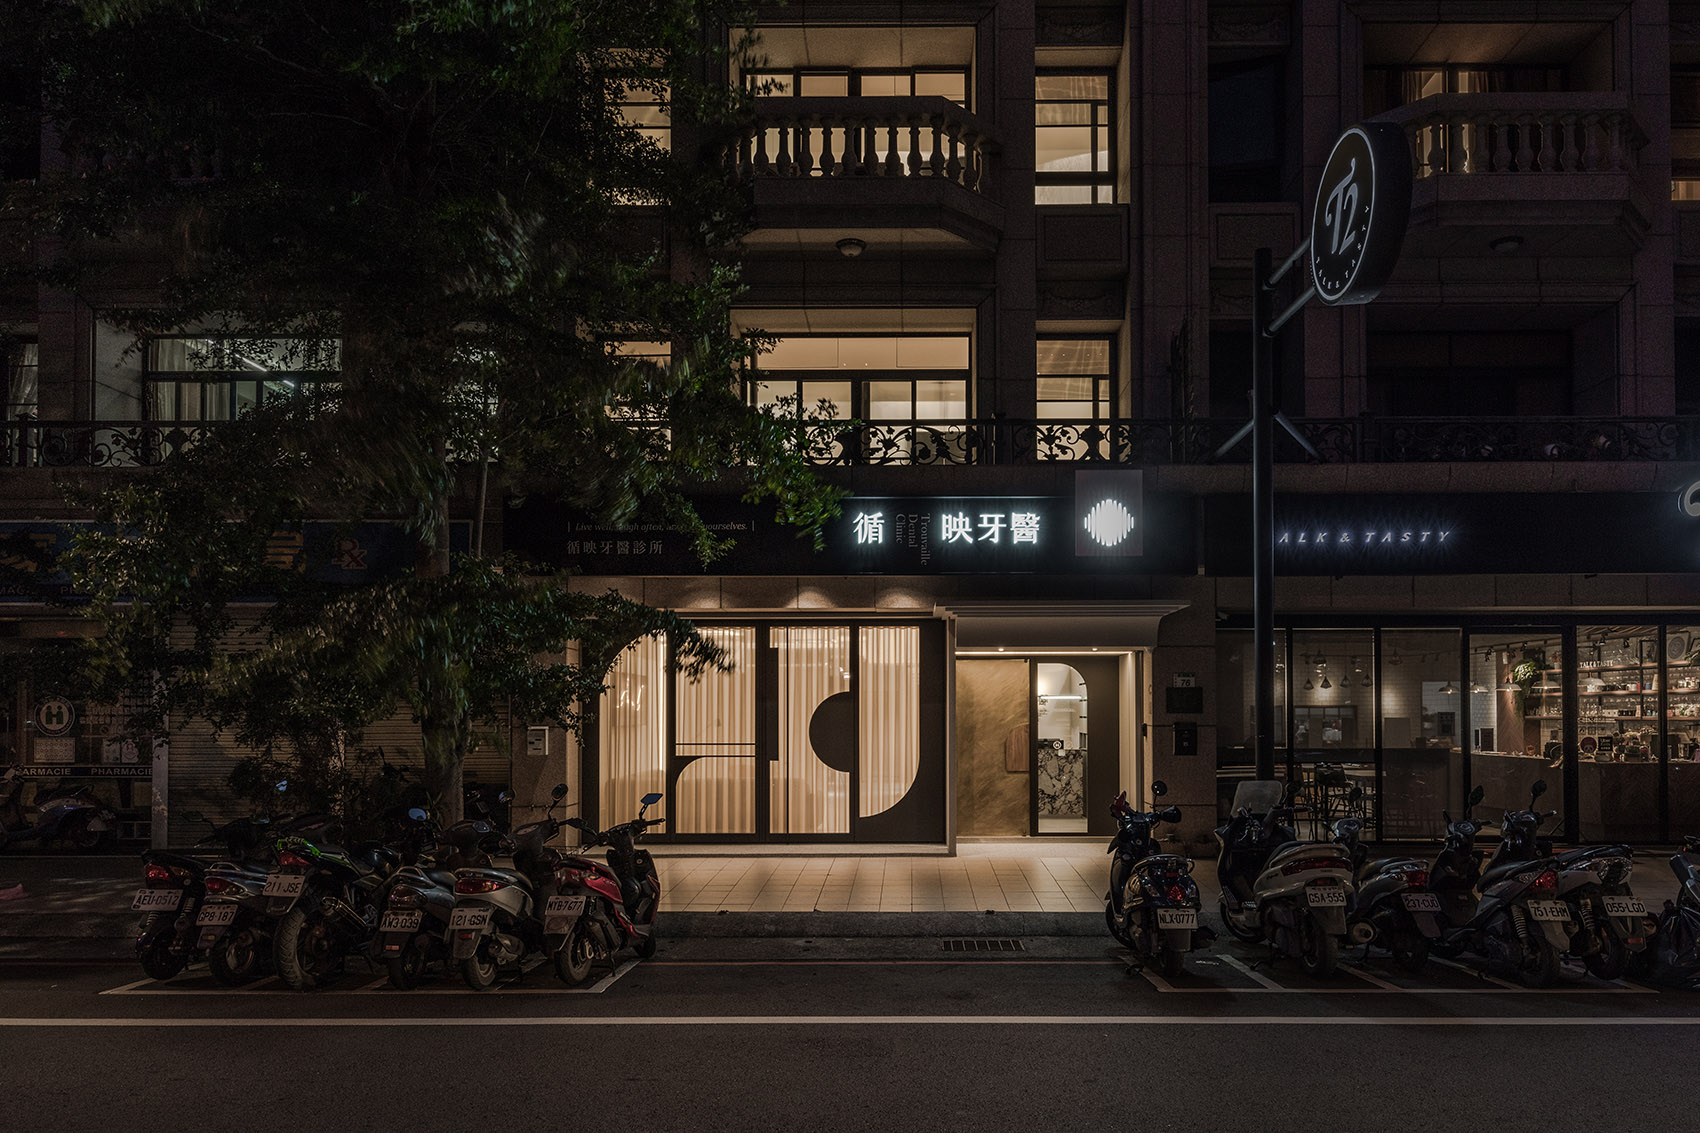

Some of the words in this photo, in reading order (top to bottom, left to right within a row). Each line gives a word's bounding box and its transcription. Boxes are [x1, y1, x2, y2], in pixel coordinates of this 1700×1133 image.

[895, 513, 907, 545] Clinic
[909, 513, 919, 548] Dental
[940, 511, 1041, 545] 映牙醫
[1279, 532, 1328, 543] ALK
[1339, 532, 1351, 543] &
[1365, 531, 1449, 543] TASTY
[567, 540, 664, 555] 循映牙醫診所
[920, 512, 931, 568] Trouvaille
[1181, 679, 1191, 687] 76
[23, 767, 72, 776] ARMACIE
